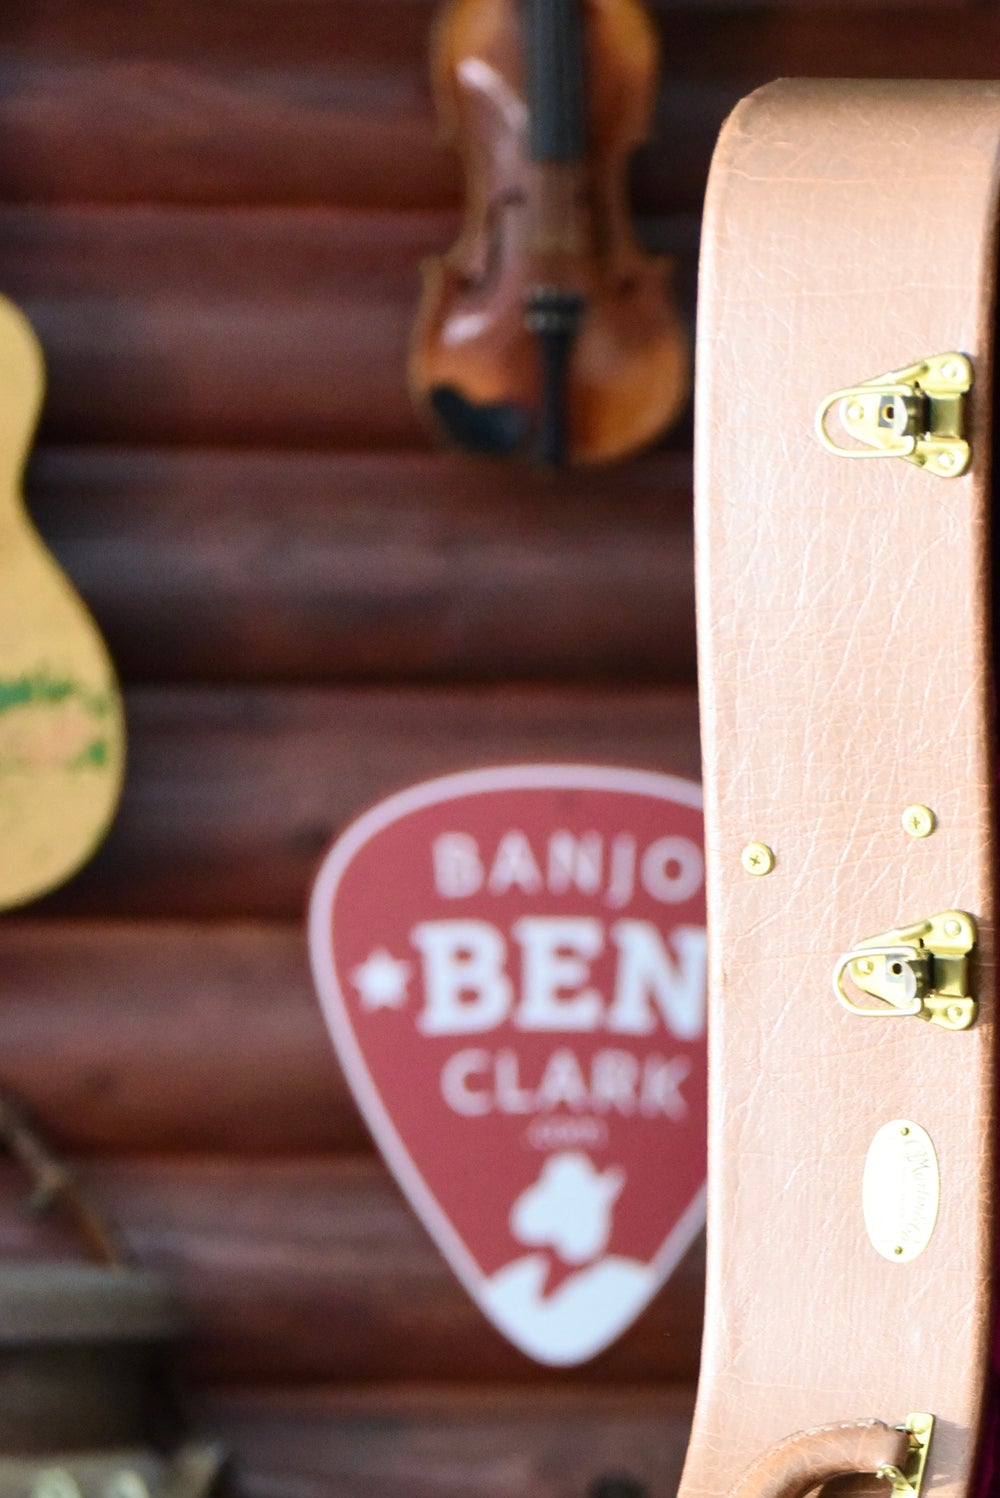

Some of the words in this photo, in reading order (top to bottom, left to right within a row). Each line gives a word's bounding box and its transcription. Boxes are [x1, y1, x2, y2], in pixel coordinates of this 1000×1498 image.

[432, 831, 703, 907] BANJO
[412, 917, 706, 1040] BEN
[440, 1048, 690, 1119] CLARK
